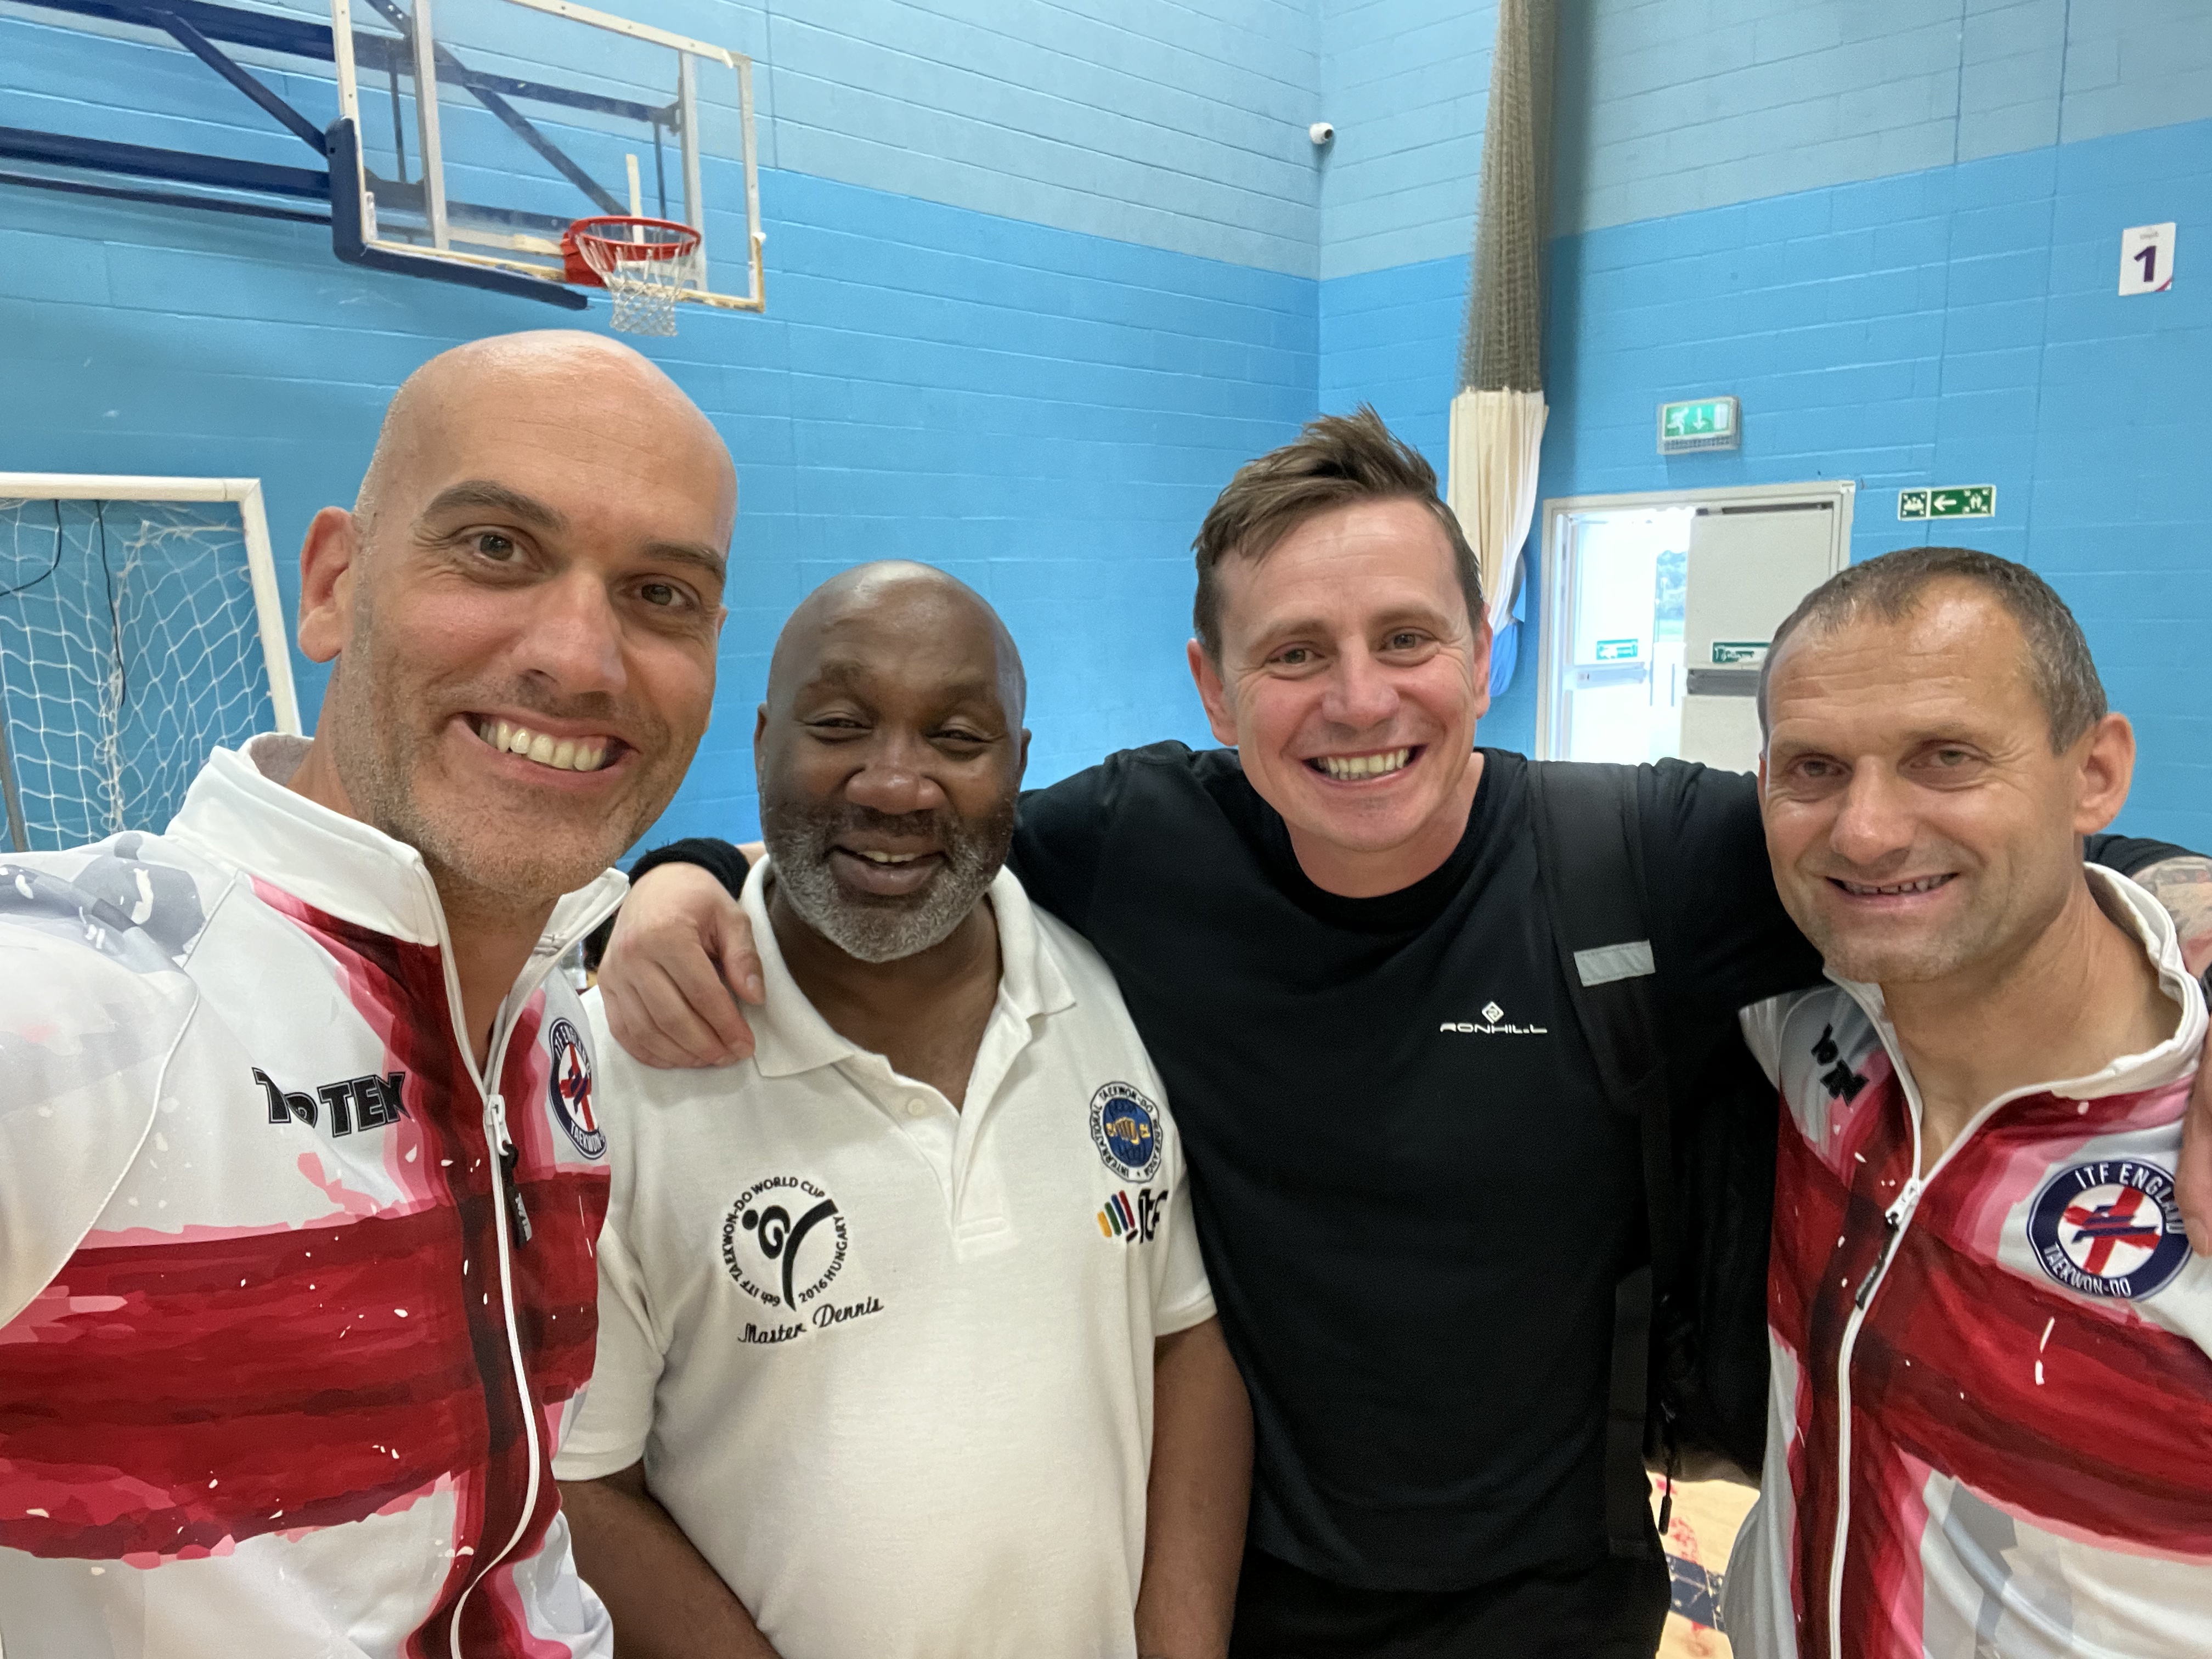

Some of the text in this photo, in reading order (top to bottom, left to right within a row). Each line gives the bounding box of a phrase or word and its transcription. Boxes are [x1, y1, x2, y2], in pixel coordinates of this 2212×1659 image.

[2134, 245, 2157, 282] 1
[1440, 1022, 1548, 1034] RONHILL
[751, 1176, 798, 1195] WORLD
[2075, 1164, 2109, 1189] ITF
[800, 1181, 825, 1198] CUP
[722, 1191, 753, 1282] TAEKWON-DO
[2042, 1241, 2132, 1297] TAEKWON-DO
[740, 1280, 760, 1297] ITF
[798, 1279, 828, 1304] 2016
[737, 1296, 884, 1344] Master Dennis
